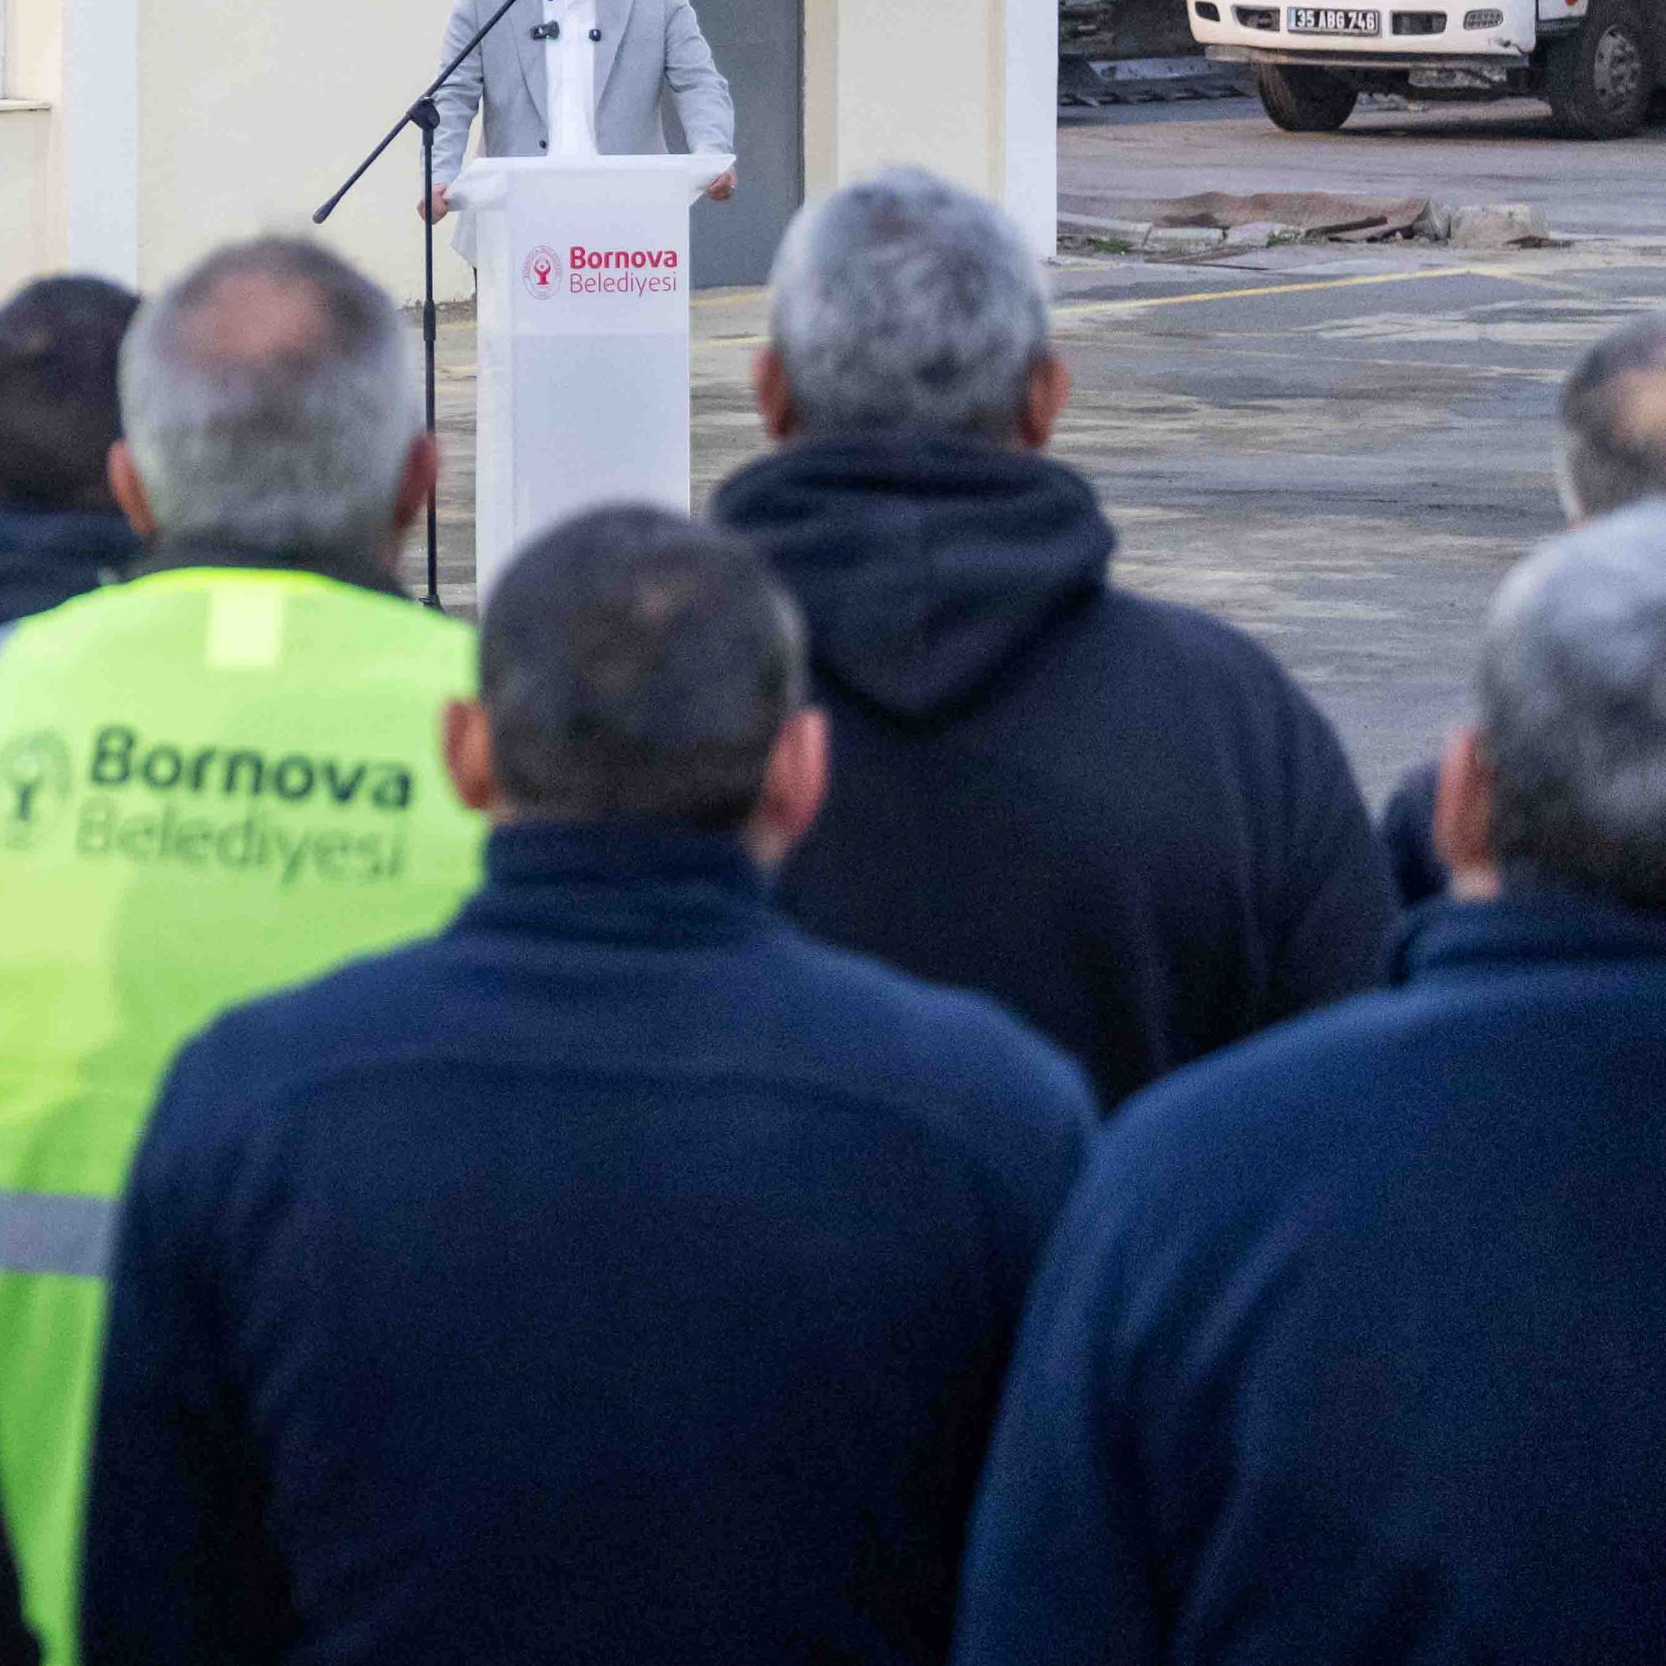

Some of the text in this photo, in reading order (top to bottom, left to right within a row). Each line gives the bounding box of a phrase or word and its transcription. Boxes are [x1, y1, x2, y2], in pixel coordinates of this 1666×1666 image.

[1297, 10, 1315, 27] 35
[570, 246, 677, 269] Bornova
[570, 272, 677, 297] Belediyesi
[90, 724, 414, 810] Bornova
[76, 794, 404, 886] Belediyesi
